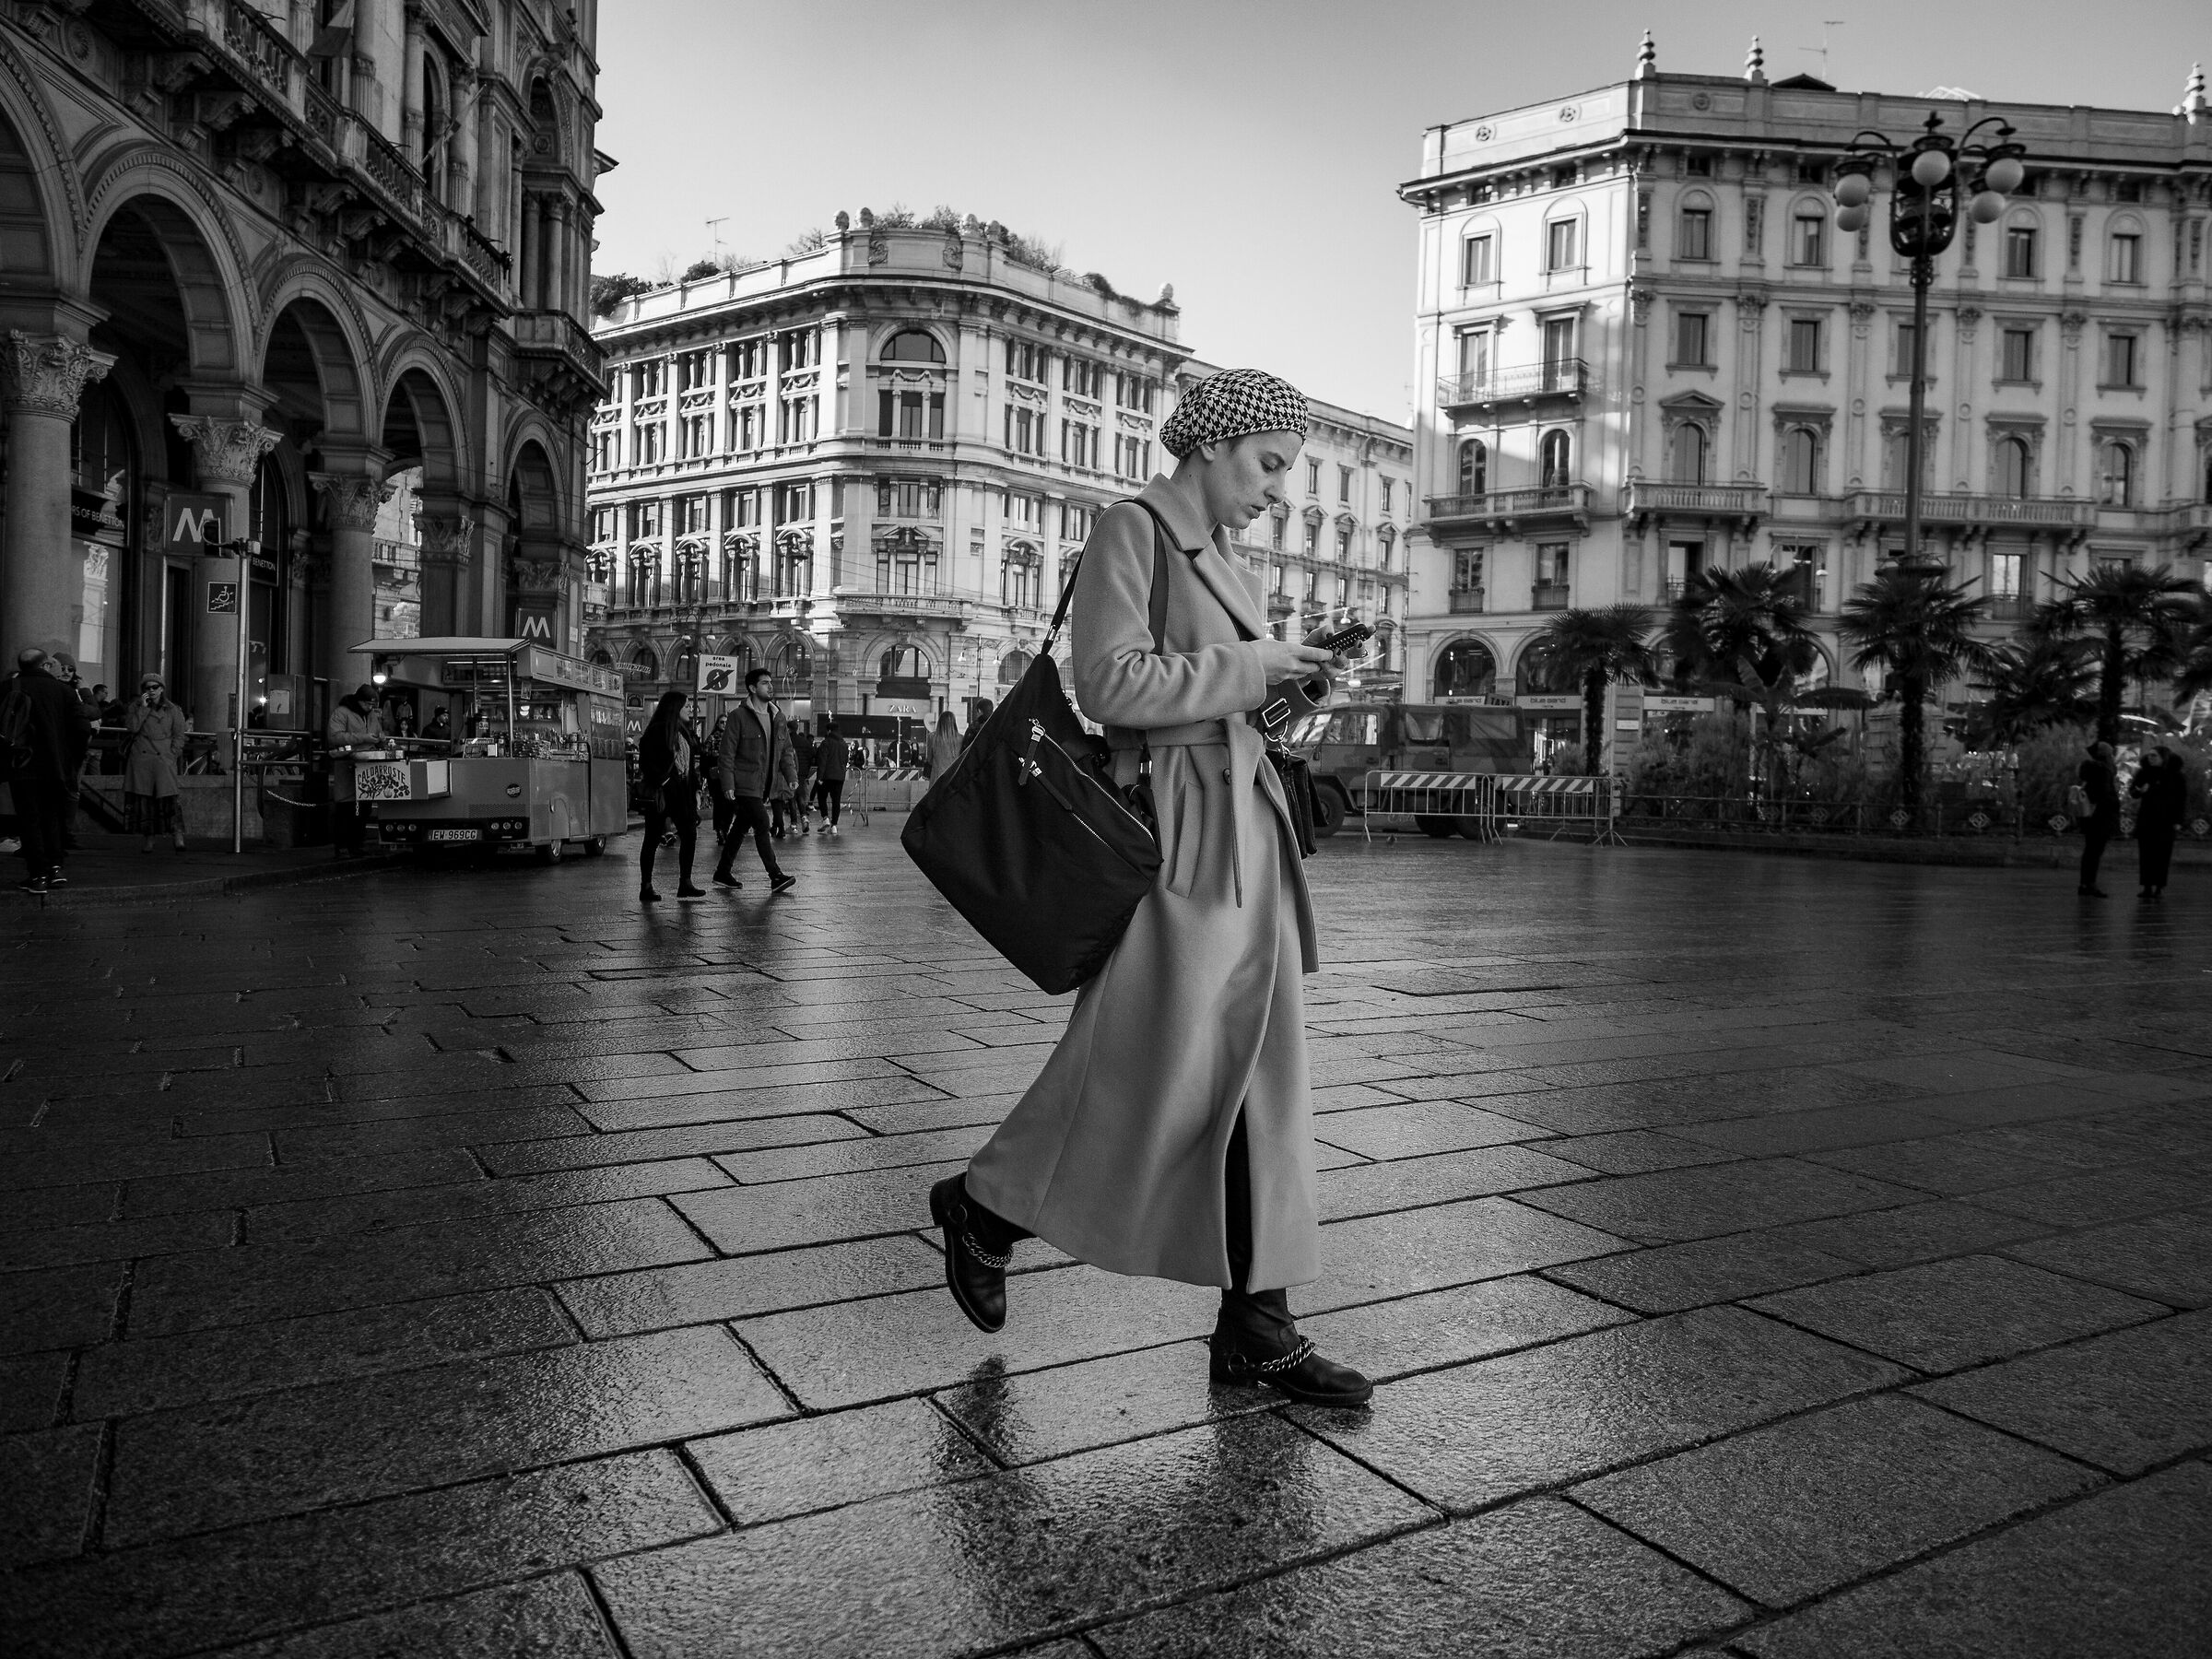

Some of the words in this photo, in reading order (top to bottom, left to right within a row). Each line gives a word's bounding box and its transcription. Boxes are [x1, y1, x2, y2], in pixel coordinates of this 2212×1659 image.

[81, 508, 90, 519] OF
[91, 511, 124, 528] BENETTON
[172, 508, 215, 542] M
[253, 557, 276, 571] BENETTON
[522, 616, 550, 638] M
[888, 704, 917, 713] ZARA
[627, 720, 641, 732] M
[358, 765, 406, 785] CALDARROSTE
[433, 830, 445, 840] EW
